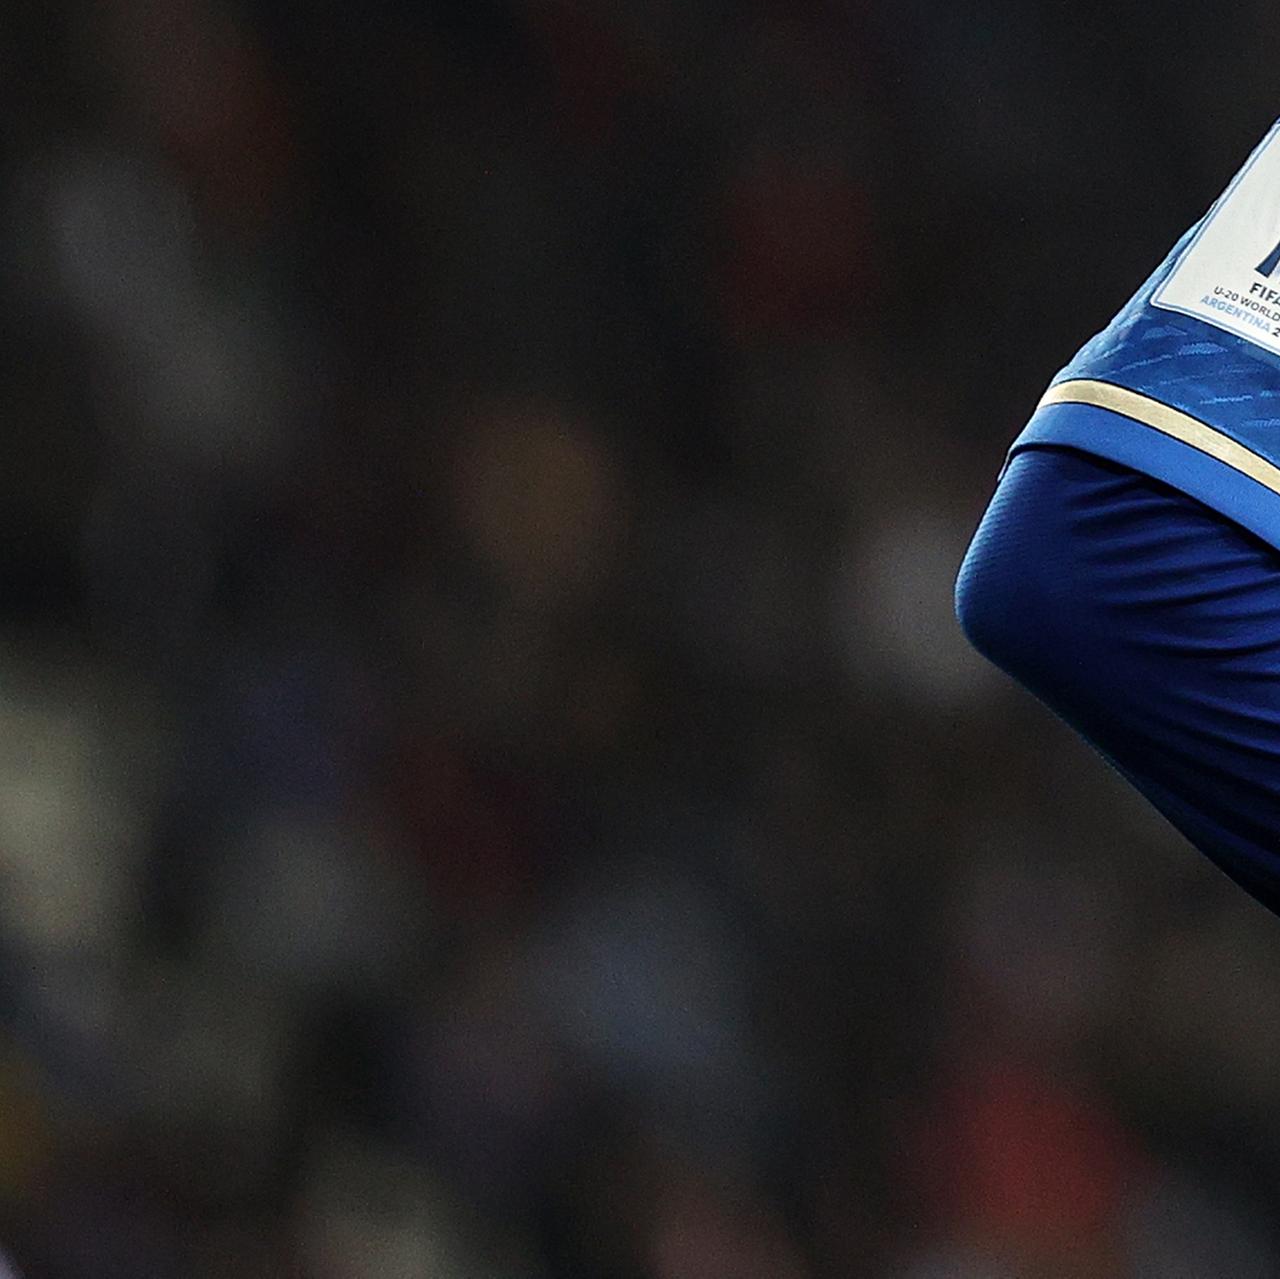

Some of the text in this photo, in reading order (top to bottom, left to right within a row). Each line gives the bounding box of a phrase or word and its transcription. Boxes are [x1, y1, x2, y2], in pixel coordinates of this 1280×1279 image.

[1200, 295, 1271, 332] ARGENTINA
[1213, 286, 1239, 302] U-20
[1240, 296, 1280, 322] WORLD
